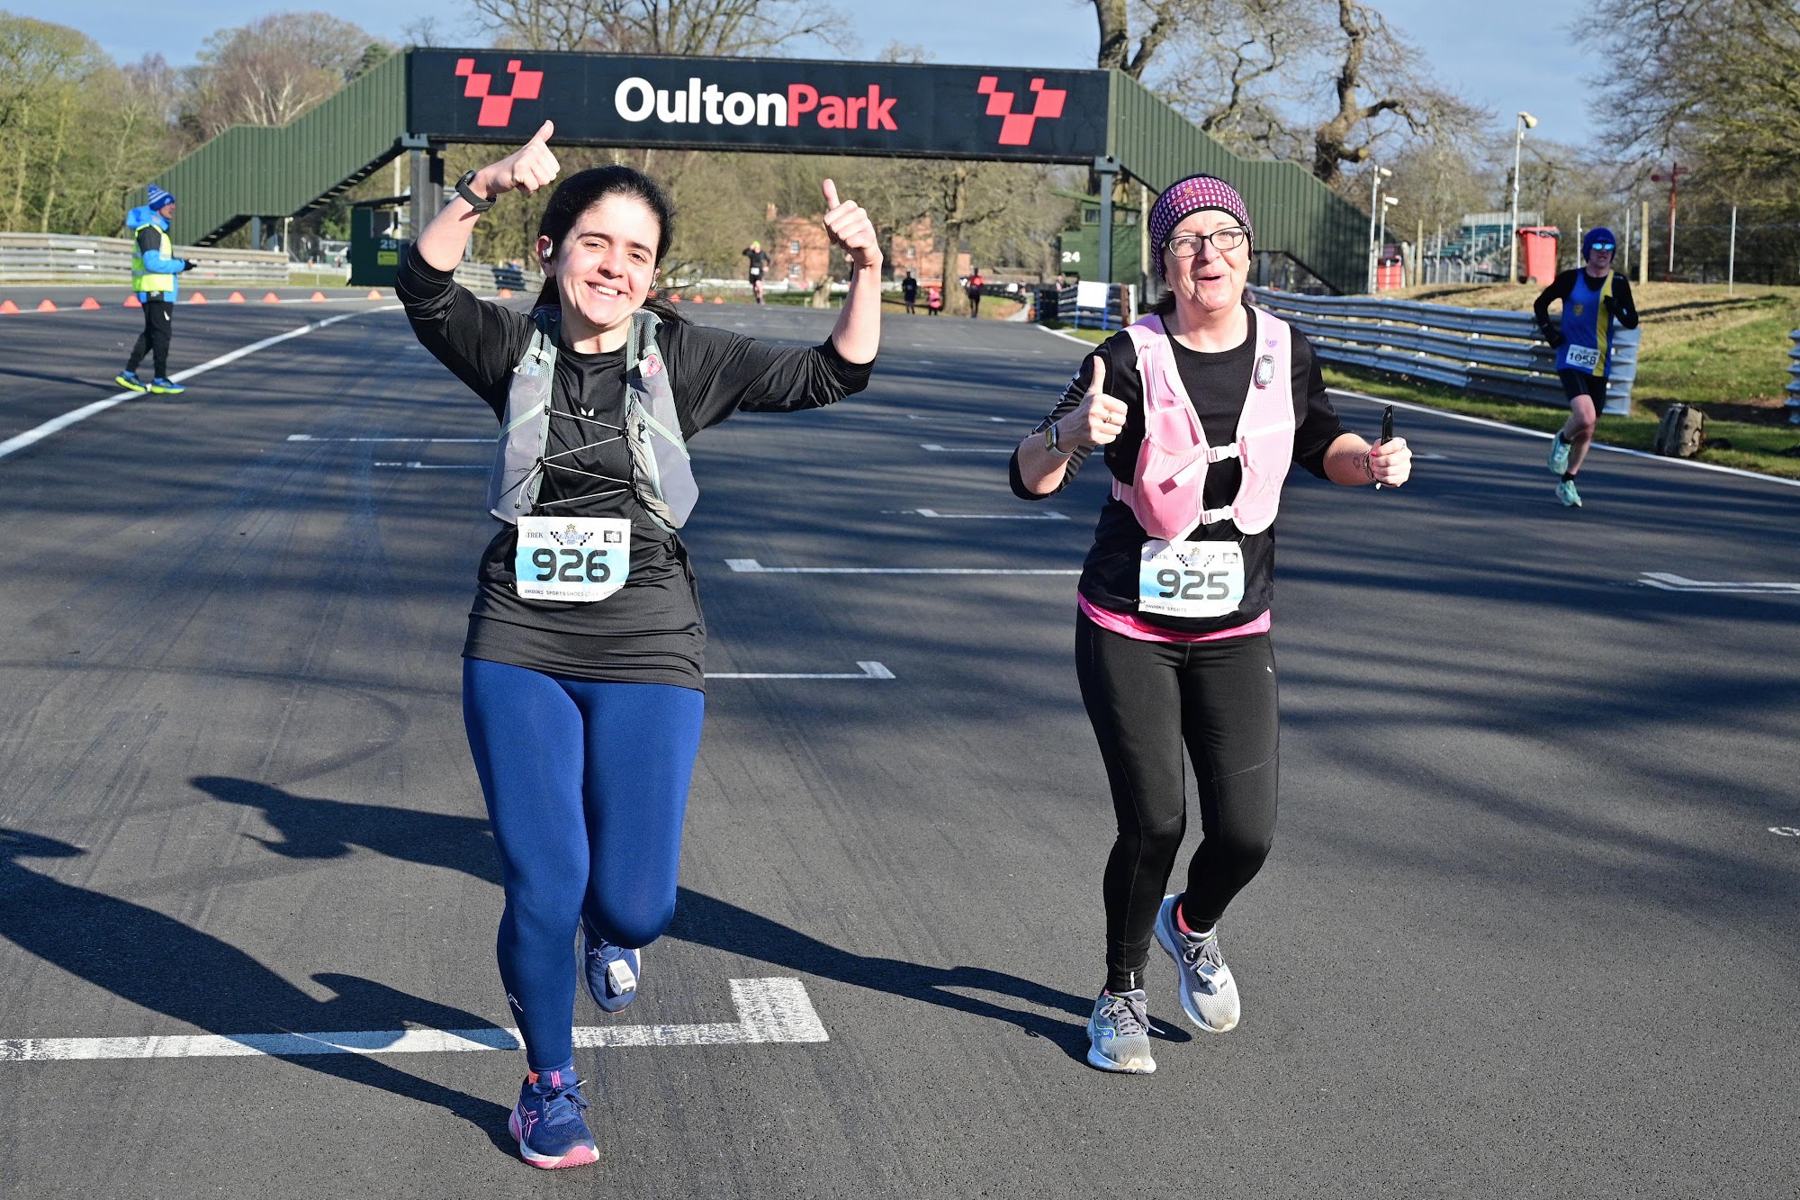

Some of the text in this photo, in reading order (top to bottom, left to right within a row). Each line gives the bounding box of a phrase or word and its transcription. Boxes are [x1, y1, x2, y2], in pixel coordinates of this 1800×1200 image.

[614, 76, 898, 131] OultonPark
[380, 239, 397, 249] 25
[1062, 251, 1081, 263] 24
[1569, 352, 1597, 366] 1058
[532, 548, 611, 583] 926
[1157, 569, 1230, 600] 925
